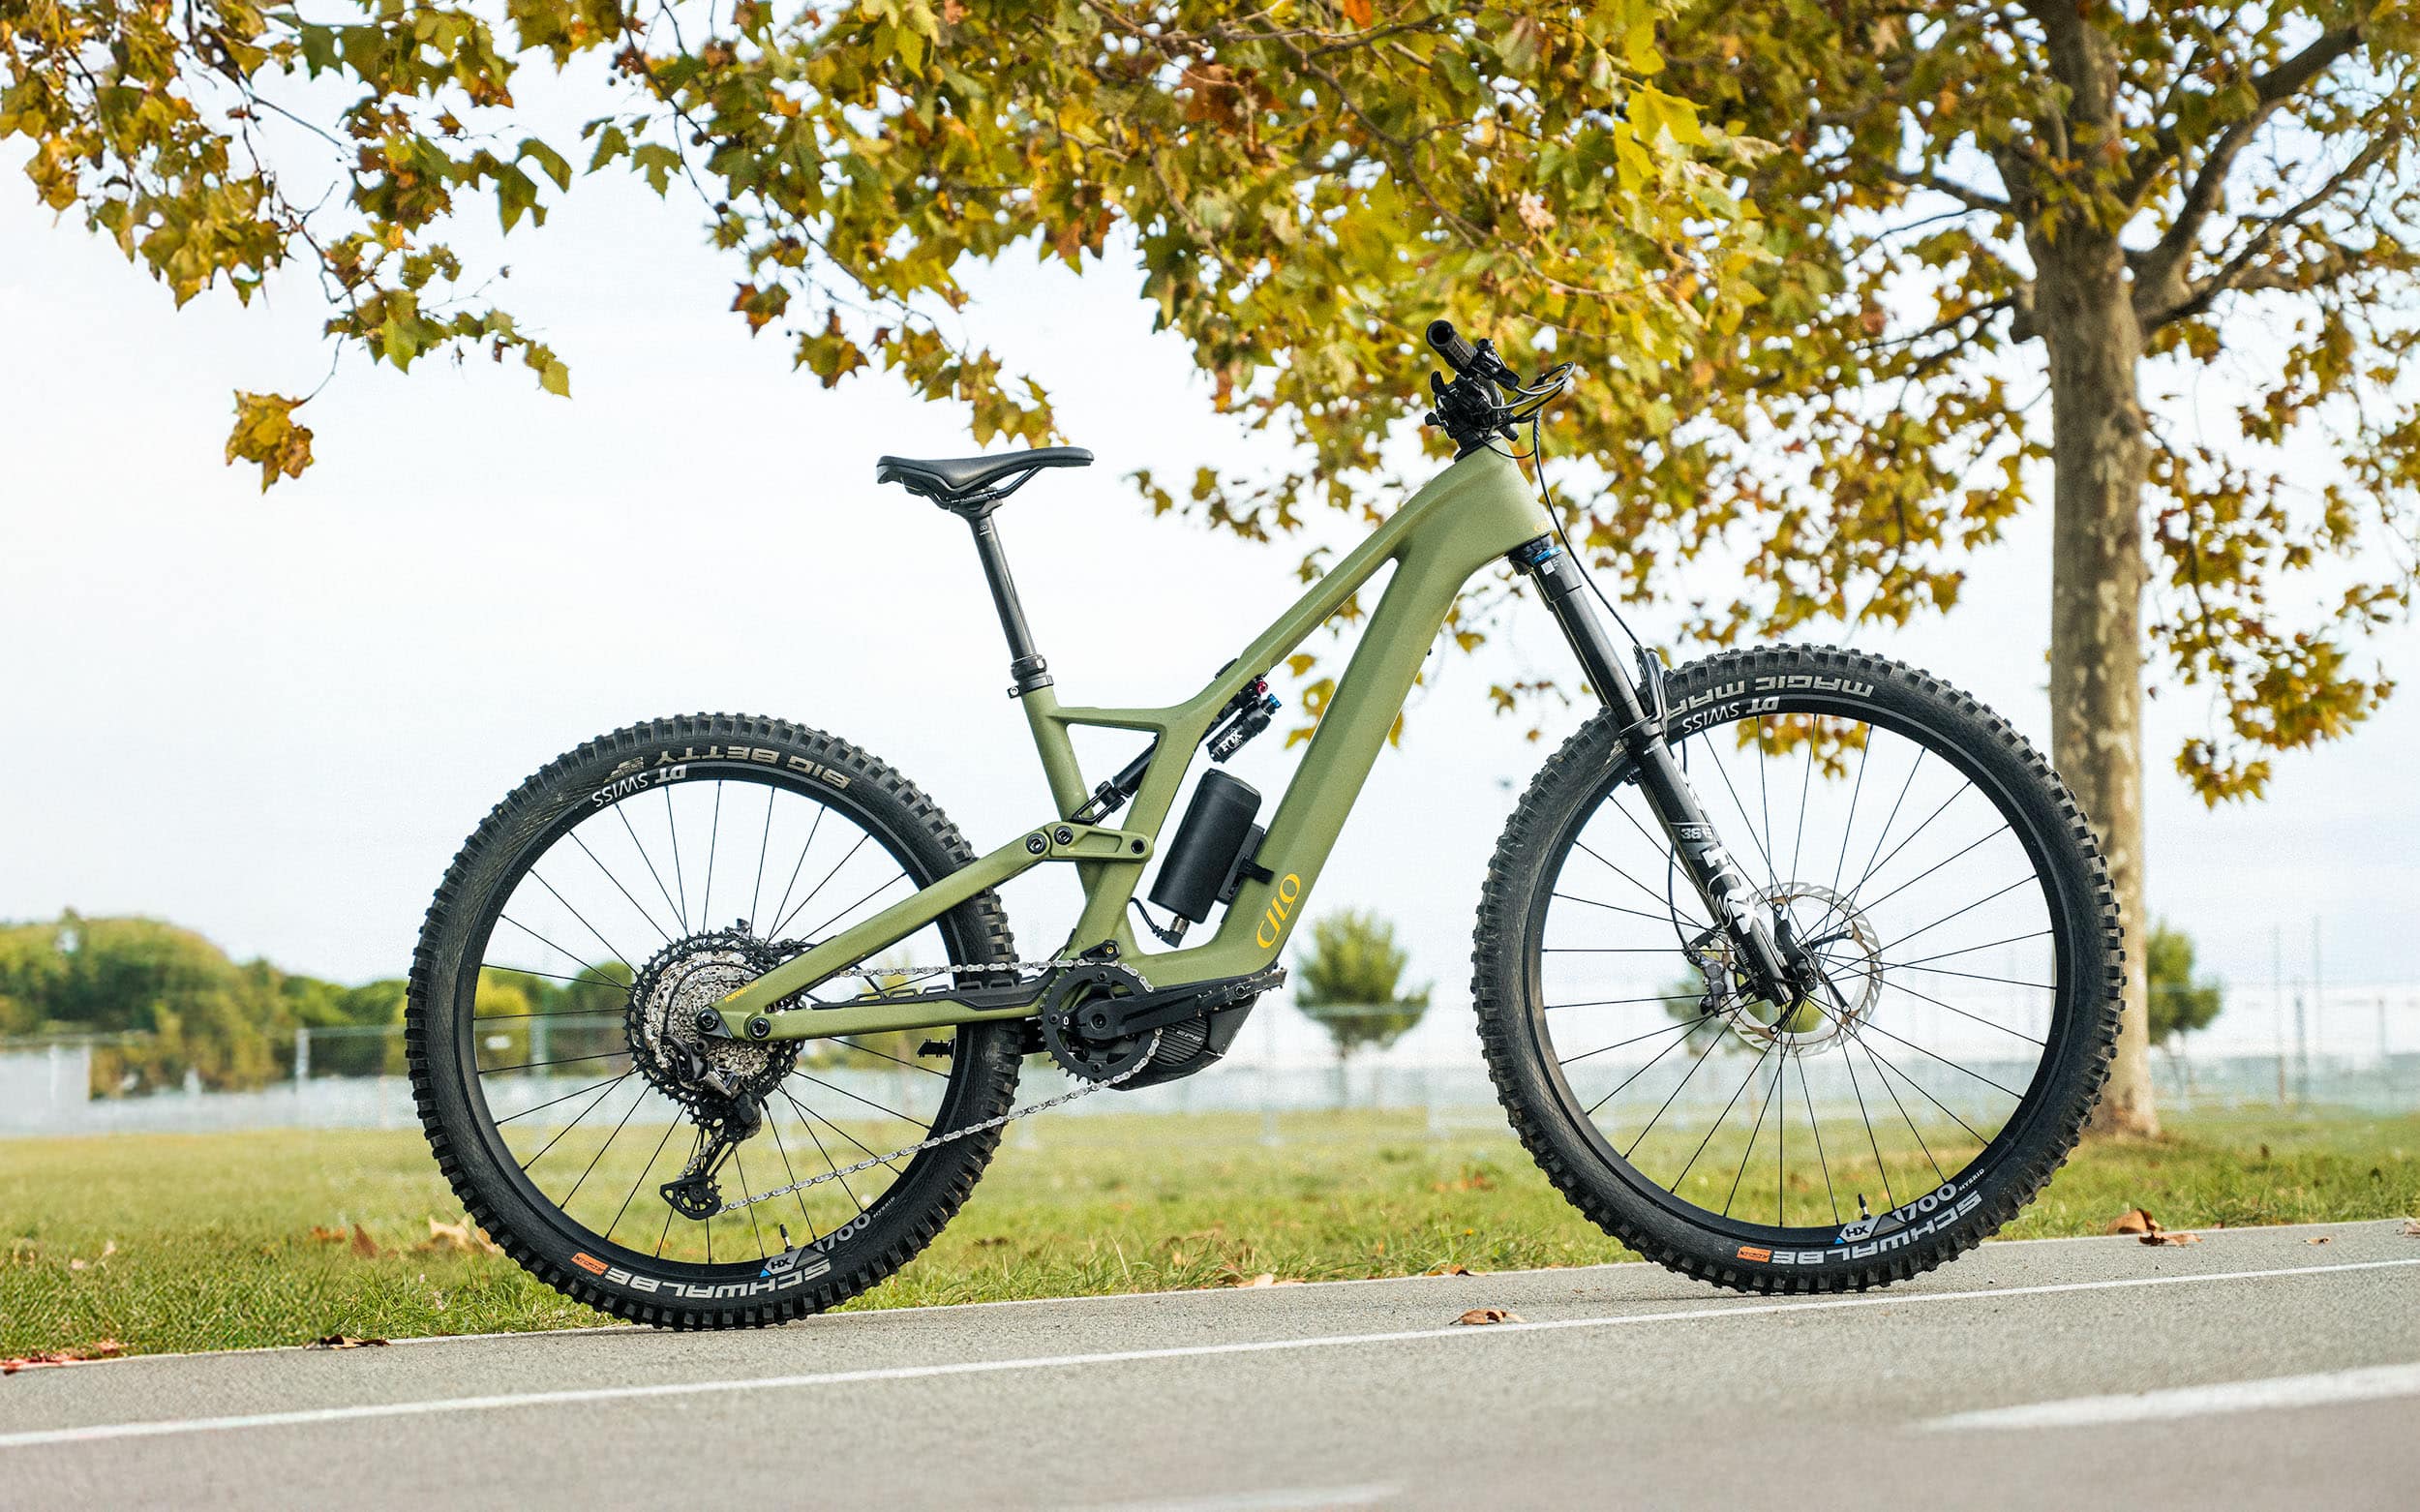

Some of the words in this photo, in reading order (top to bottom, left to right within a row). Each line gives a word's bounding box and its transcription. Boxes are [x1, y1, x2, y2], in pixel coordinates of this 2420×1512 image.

[1665, 680, 1746, 721] MAR
[1754, 674, 1874, 698] MAGIC
[1681, 701, 1740, 734] SWISS
[1745, 695, 1781, 714] DT
[653, 744, 780, 767] BETTY
[654, 764, 688, 787] DT
[785, 755, 853, 790] BIG
[590, 772, 650, 808] SWISS
[1255, 872, 1302, 950] CILO
[1957, 1167, 1985, 1192] HYBRID
[871, 1194, 896, 1219] HYBRID
[1892, 1182, 1957, 1223] 1700
[813, 1212, 872, 1255] 1700
[1771, 1190, 1983, 1265] SCHWALBE
[1845, 1225, 1869, 1238] HX
[602, 1257, 832, 1299] SCHWALBE
[771, 1257, 792, 1271] HX
